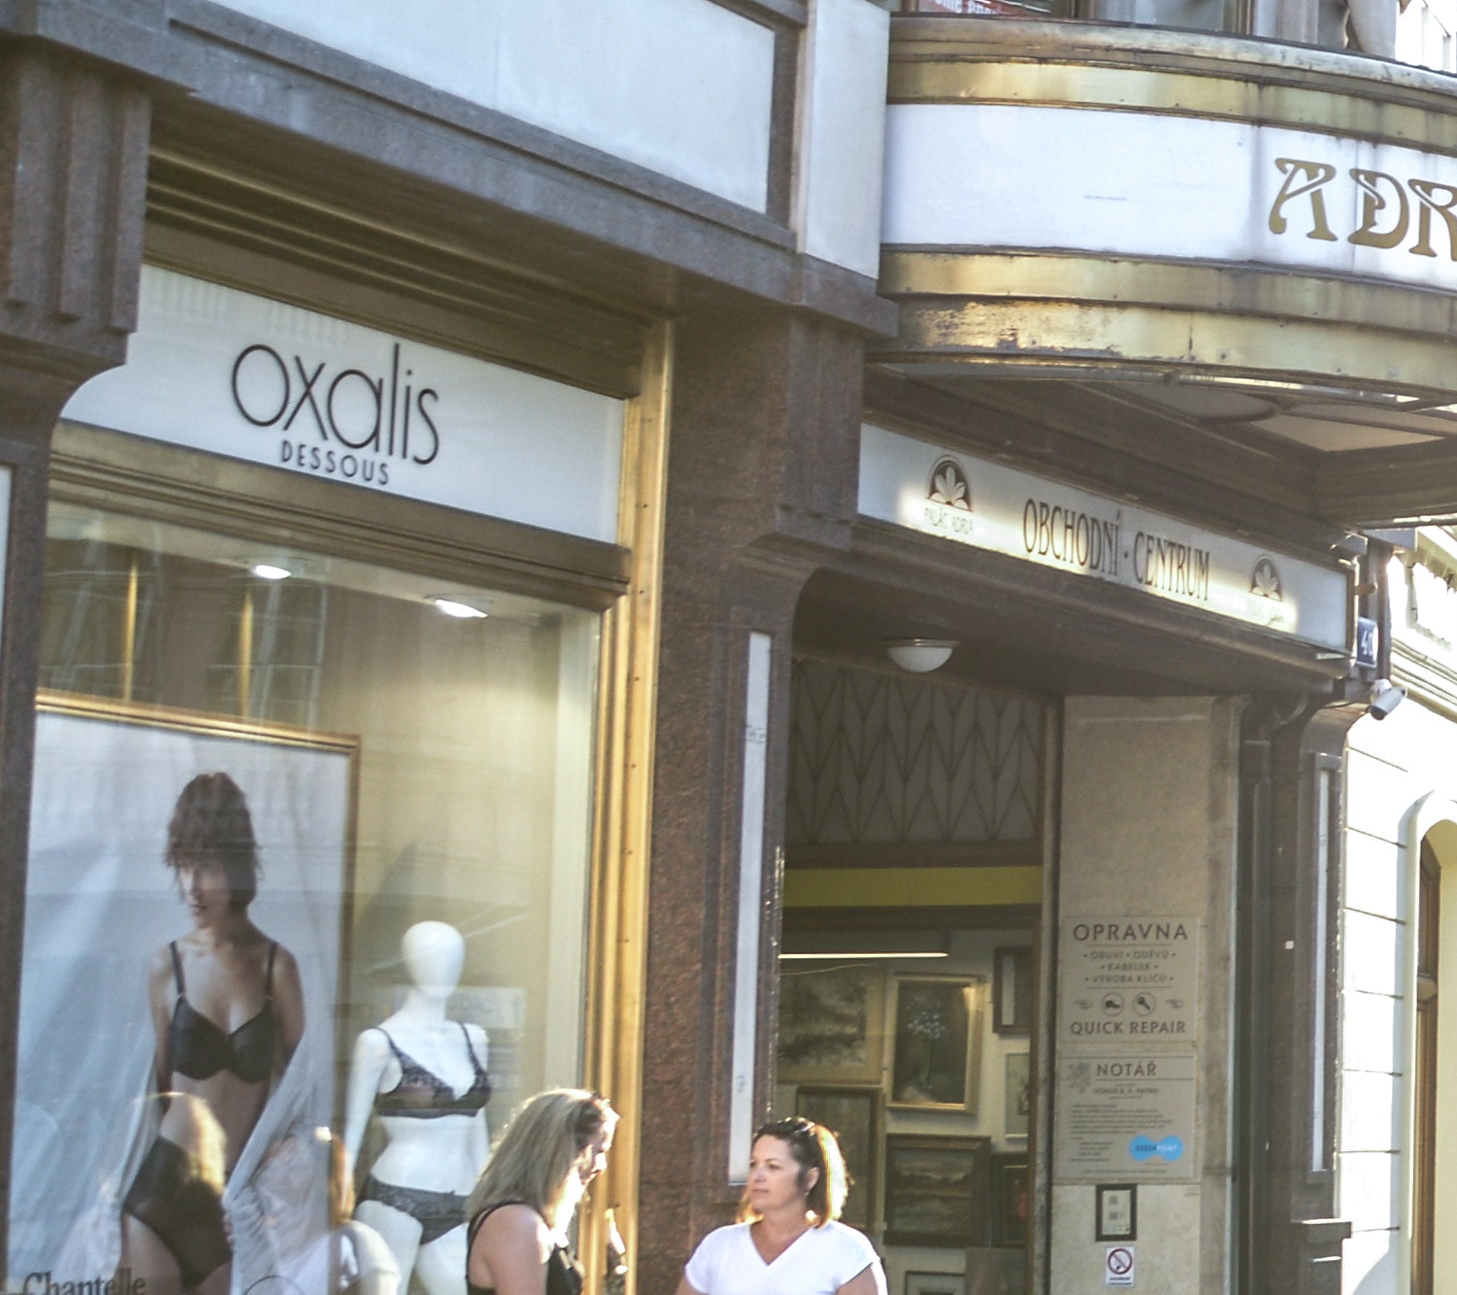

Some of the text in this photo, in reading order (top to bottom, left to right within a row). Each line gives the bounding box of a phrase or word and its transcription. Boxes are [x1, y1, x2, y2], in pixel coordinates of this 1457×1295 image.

[281, 439, 390, 486] DESSOUS
[1022, 498, 1211, 601] OBCHODNÍ CENTRUM
[1072, 923, 1189, 942] OPRAVNA
[1107, 962, 1151, 972] KABELEK
[1070, 1020, 1186, 1036] QUICK REPAIR
[1095, 1060, 1158, 1077] NOTÁŘ
